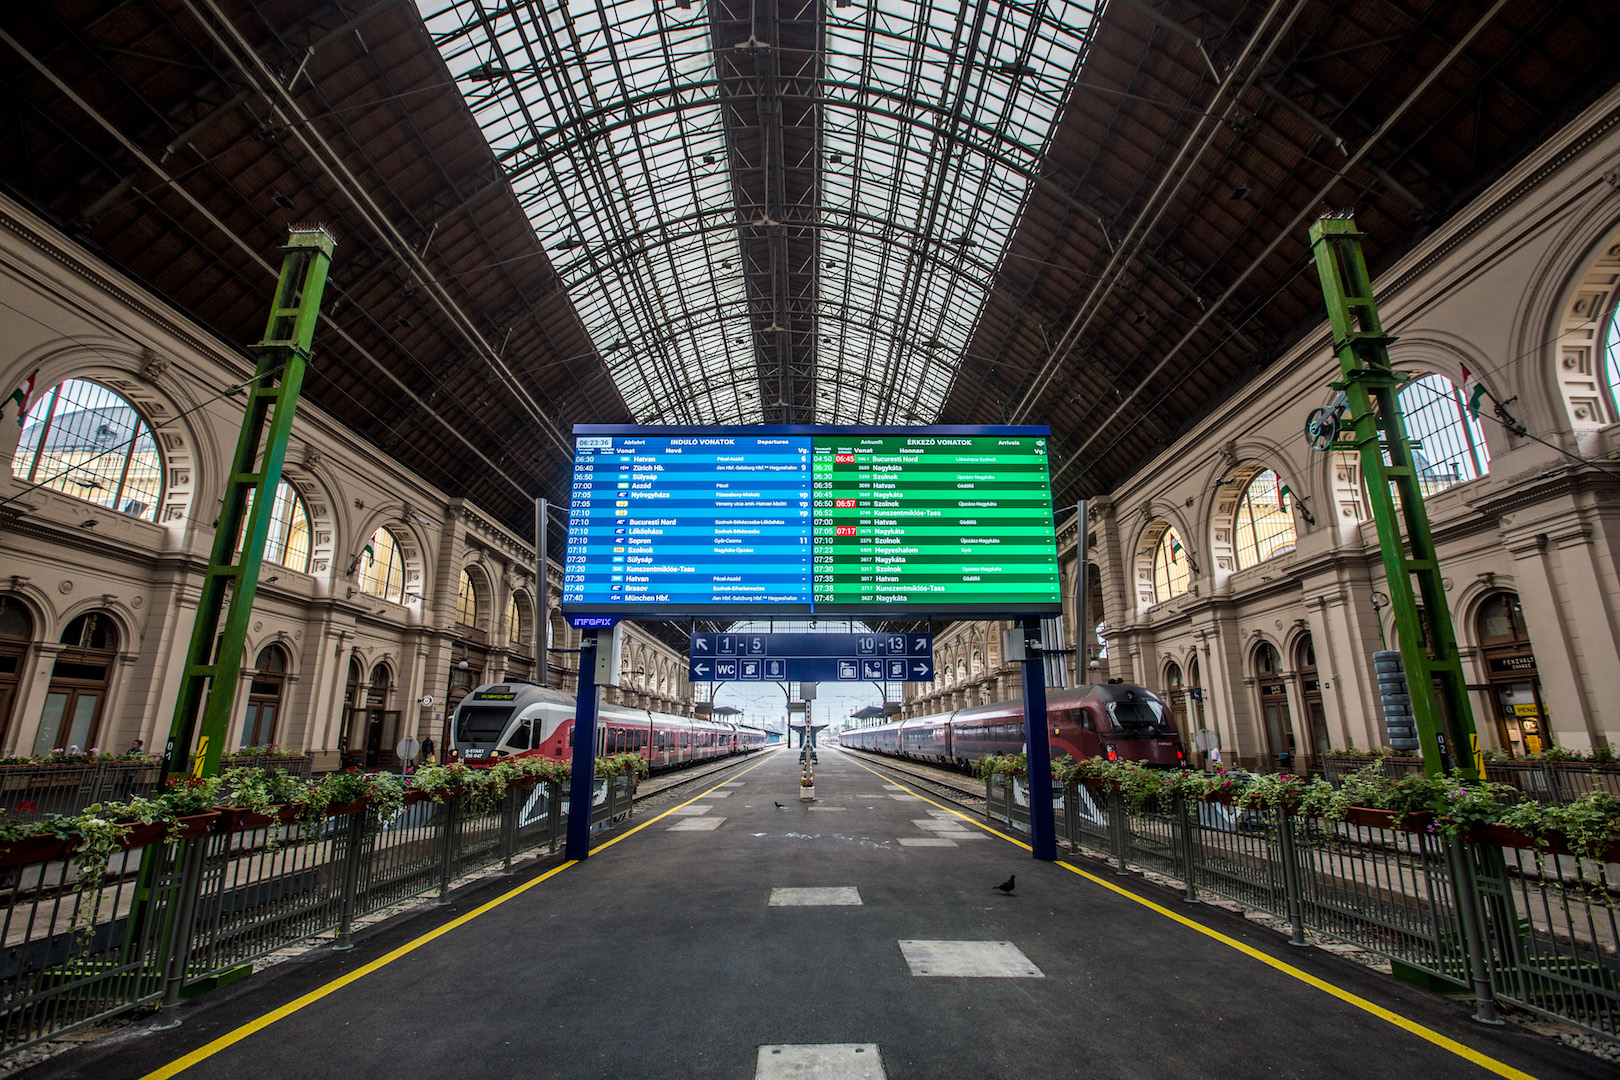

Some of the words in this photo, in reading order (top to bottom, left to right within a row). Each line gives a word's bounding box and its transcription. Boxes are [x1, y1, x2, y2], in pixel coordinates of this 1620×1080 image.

[627, 556, 653, 564] Sülysáp
[723, 638, 729, 649] 1
[753, 638, 760, 649] 5
[859, 638, 874, 649] 10
[888, 637, 903, 649] 13
[718, 665, 734, 674] WC
